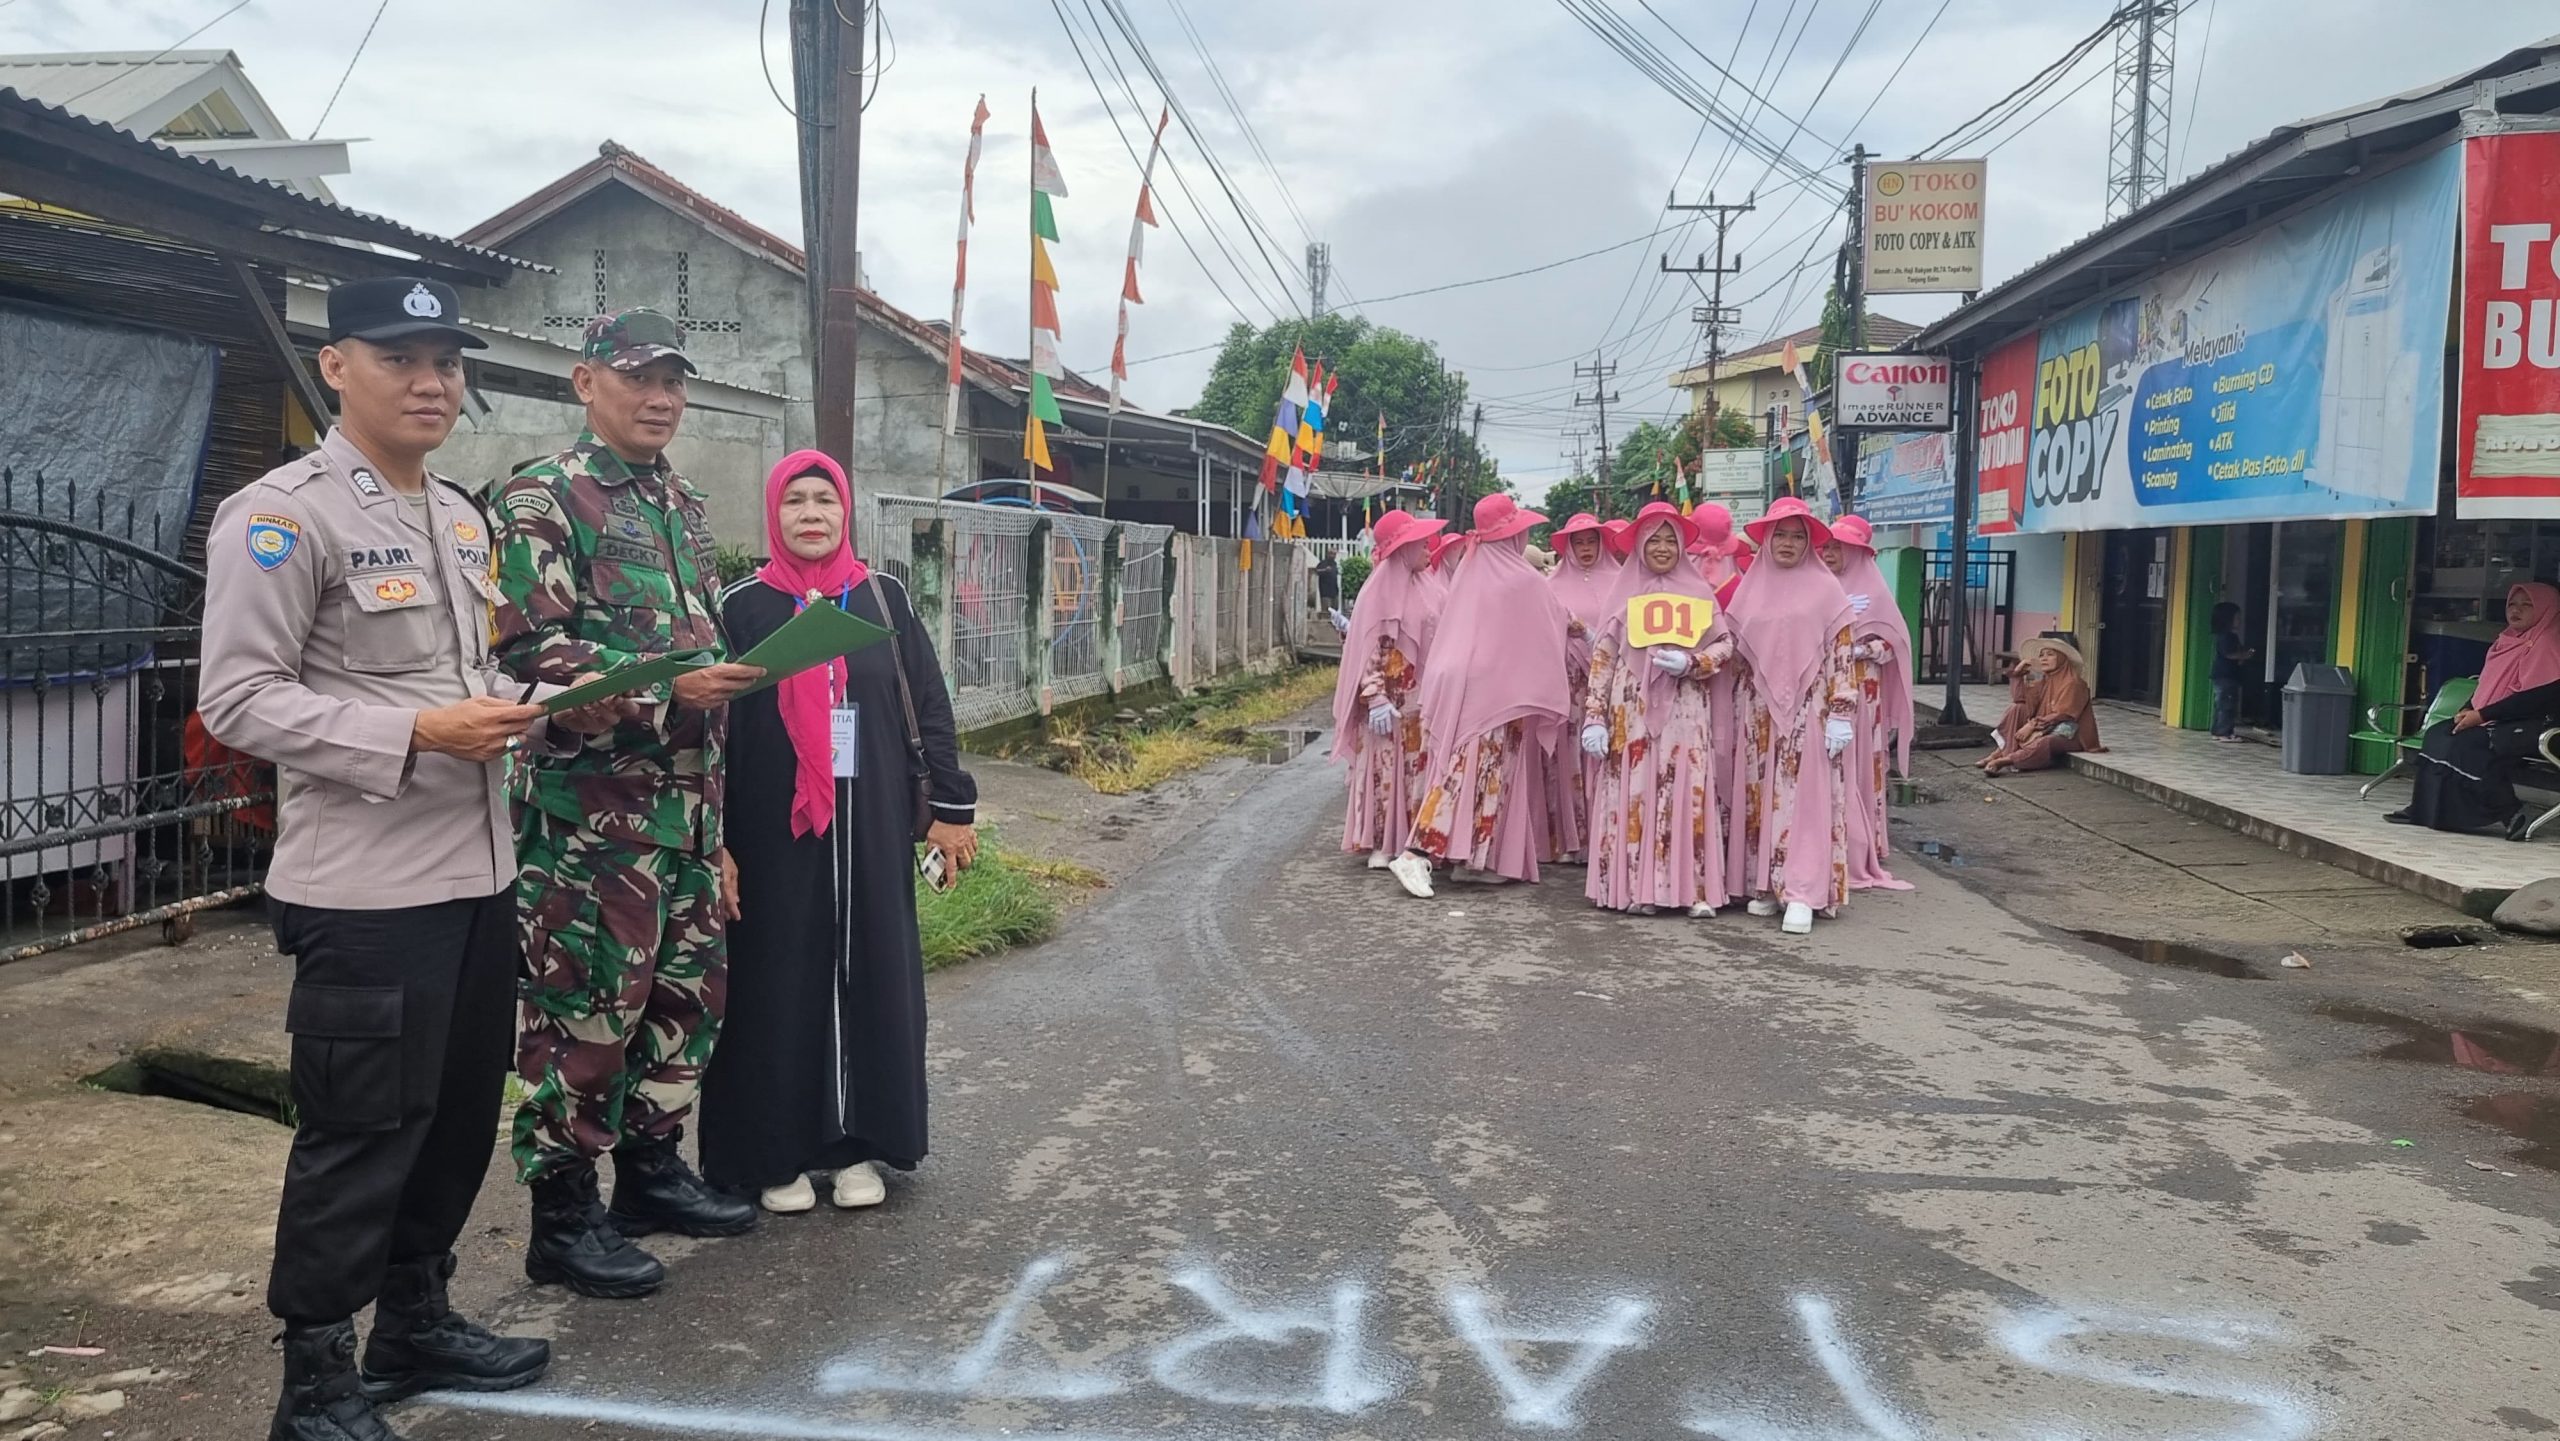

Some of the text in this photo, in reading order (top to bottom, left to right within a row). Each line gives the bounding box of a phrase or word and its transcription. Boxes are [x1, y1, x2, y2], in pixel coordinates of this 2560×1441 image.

[1909, 172, 1977, 192] TOKO
[1910, 202, 1978, 220] KOKOM
[1874, 231, 1976, 251] FOTO COPY & ATK
[1845, 363, 1947, 384] Canon
[2217, 363, 2274, 393] Burning CD
[2036, 341, 2101, 430] FOTO
[1843, 403, 1944, 411] imageRUNNER
[2151, 387, 2193, 410] Cetak Foto
[1854, 412, 1934, 423] ADVANCE
[1981, 390, 2018, 433] TOKO
[2215, 401, 2236, 424] Jilid
[2148, 414, 2180, 437] Printing
[2147, 439, 2193, 462] Laminating
[2214, 431, 2234, 452] ATK
[2031, 411, 2117, 502] COPY
[2145, 467, 2178, 490] Scaning
[2213, 460, 2240, 481] Cetak
[2241, 459, 2261, 478] Pas
[508, 498, 547, 510] KOMANDO
[256, 517, 295, 530] BINMAS
[351, 548, 414, 569] PAJRI
[606, 544, 658, 564] DECKY
[1644, 600, 1694, 638] 01
[832, 714, 853, 724] ITIA
[812, 1250, 2338, 1441] START
